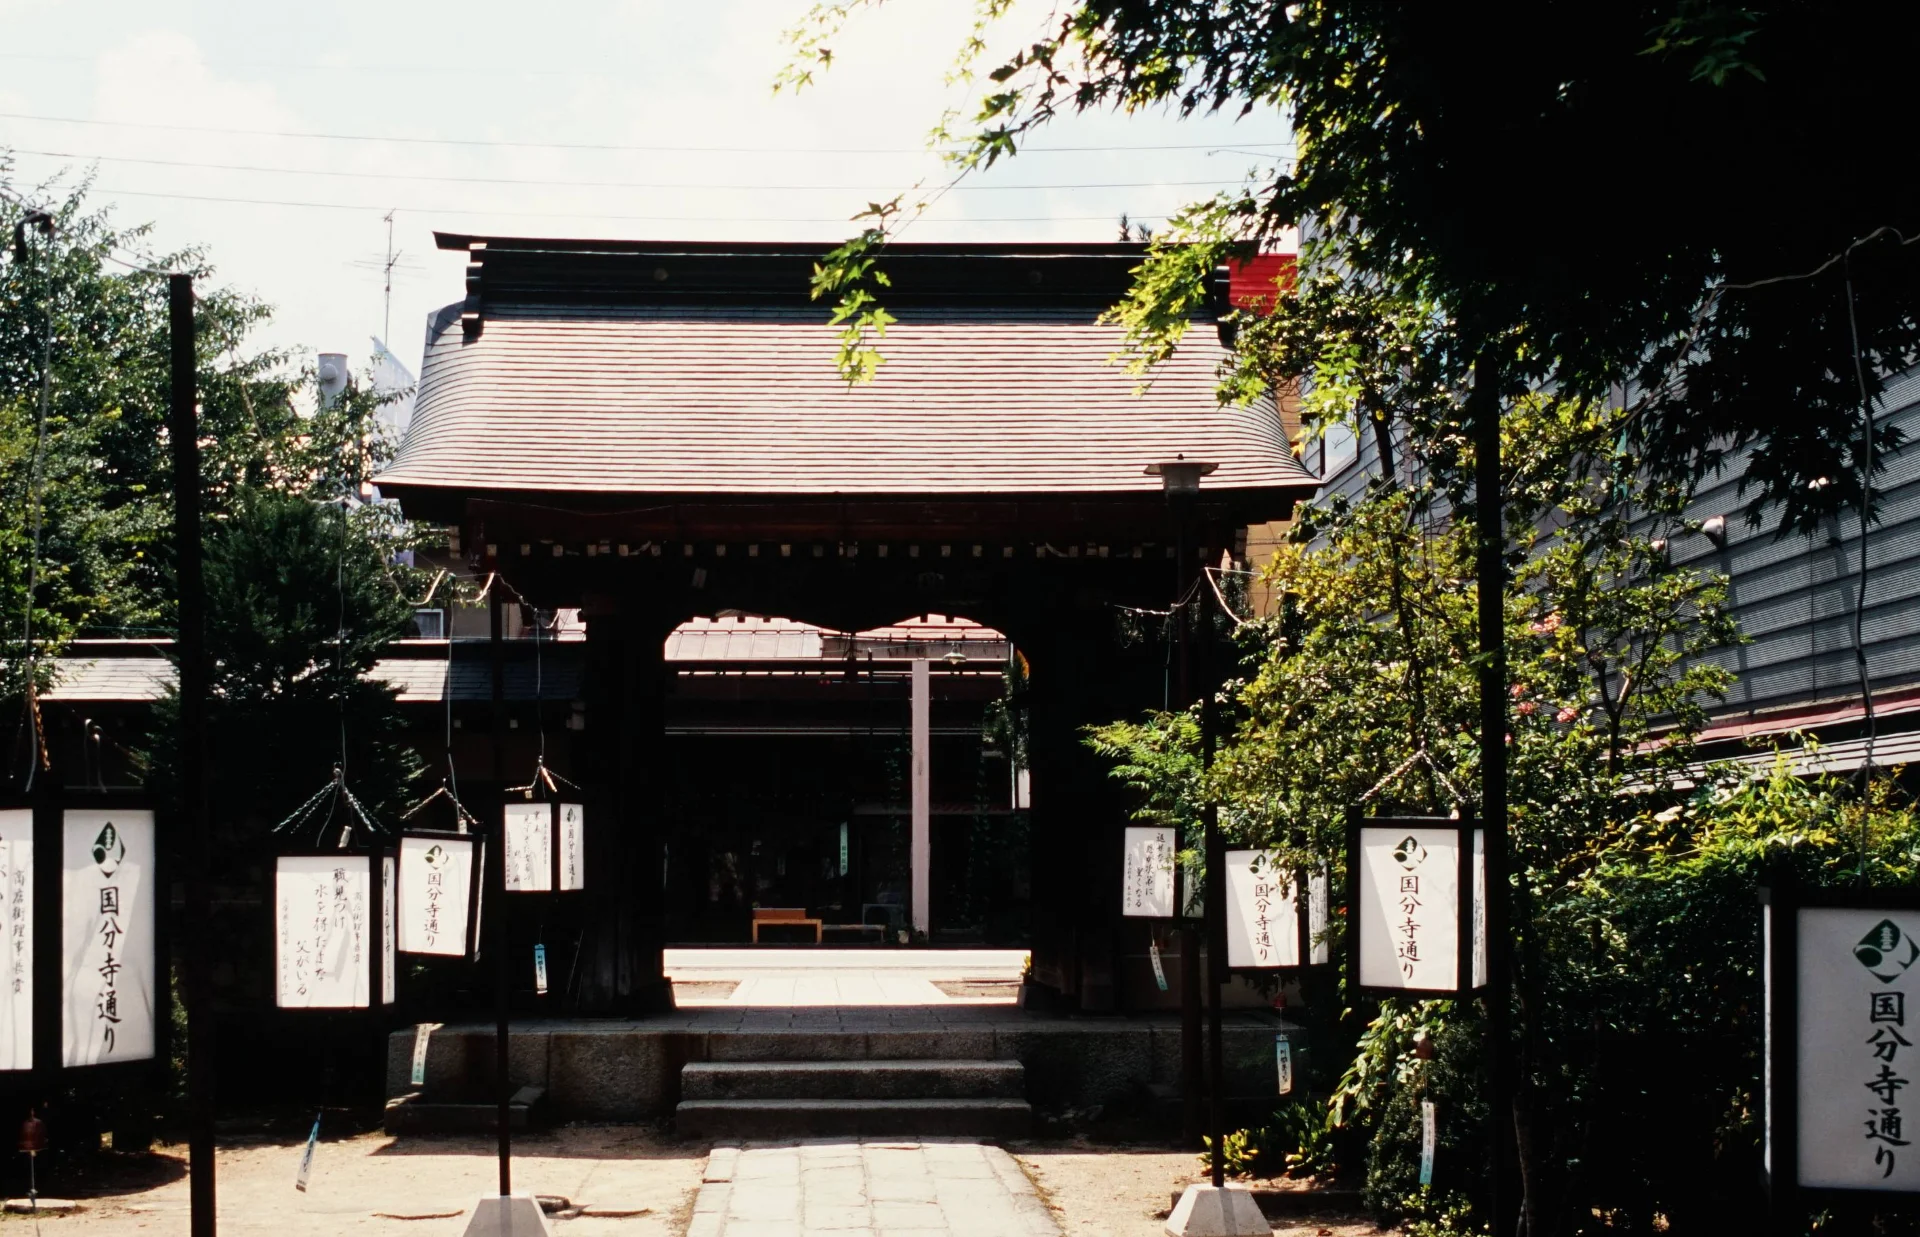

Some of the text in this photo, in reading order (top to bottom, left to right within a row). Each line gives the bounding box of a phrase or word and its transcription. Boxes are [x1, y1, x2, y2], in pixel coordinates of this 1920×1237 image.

[424, 872, 443, 948] 国分寺通り
[1255, 883, 1273, 961] 国分寺通り
[1398, 875, 1423, 980] 国分寺通り
[97, 886, 122, 1054] 国分寺通り
[1864, 991, 1913, 1180] 国分寺通り
